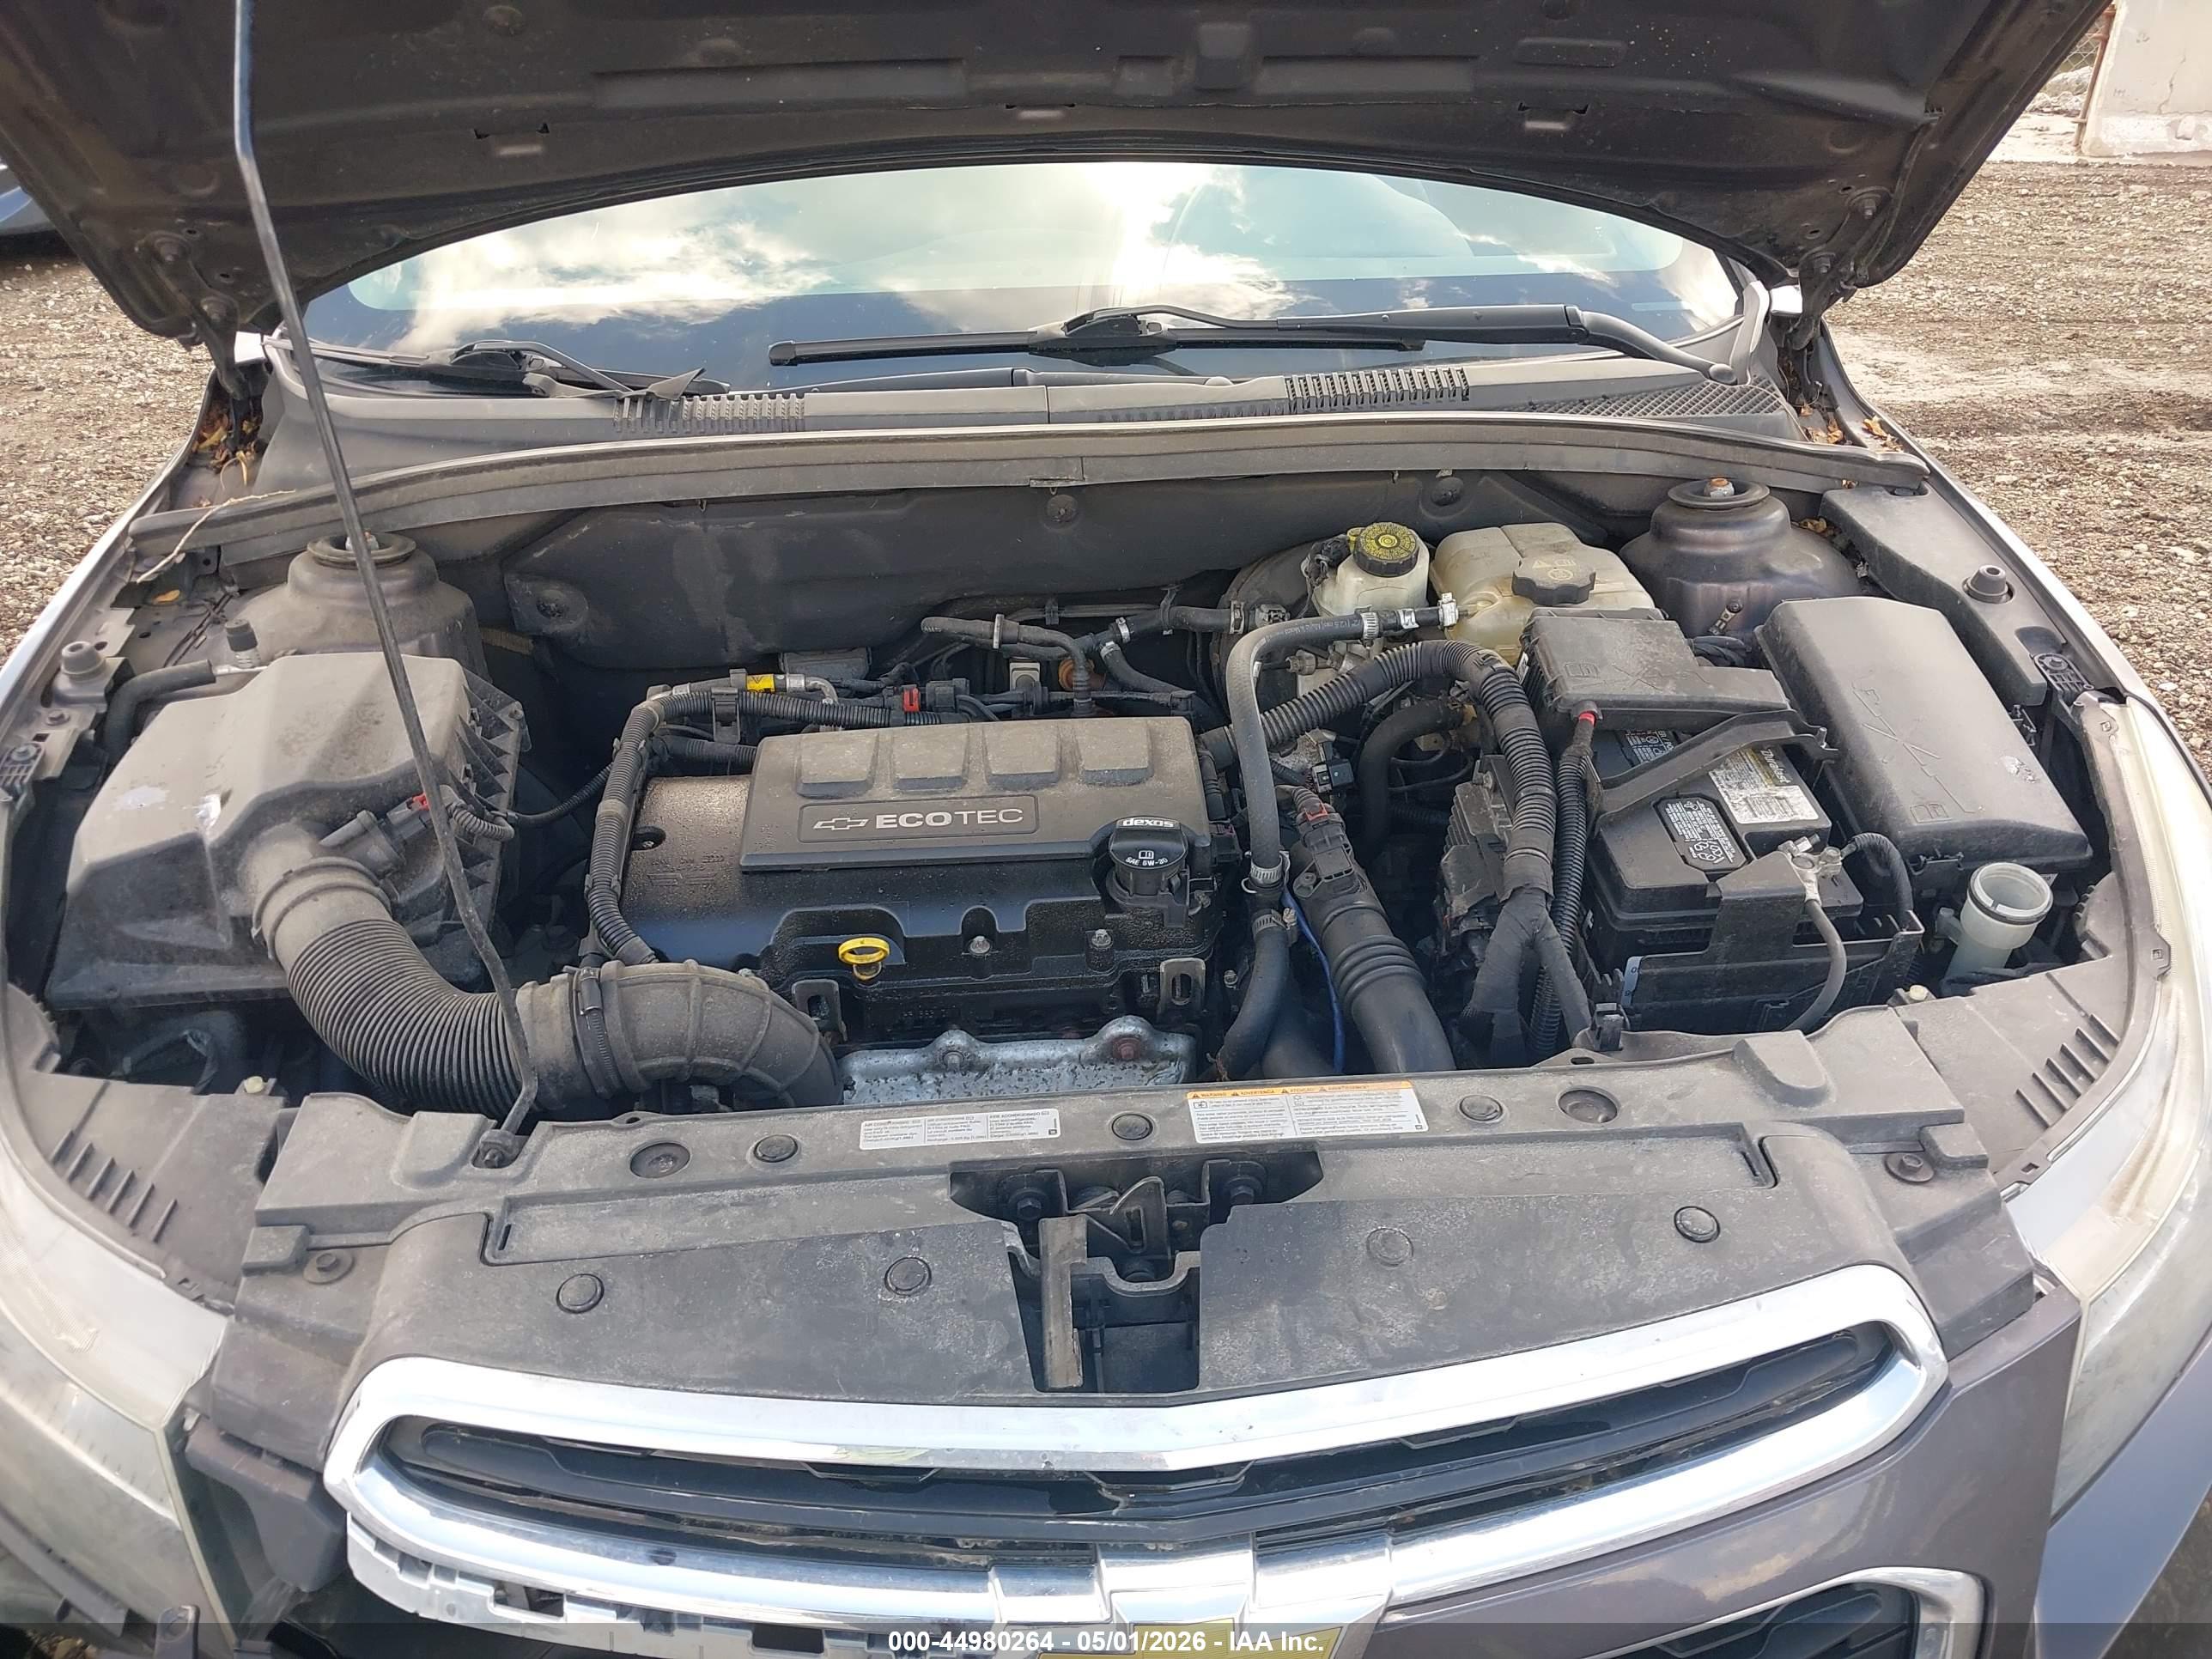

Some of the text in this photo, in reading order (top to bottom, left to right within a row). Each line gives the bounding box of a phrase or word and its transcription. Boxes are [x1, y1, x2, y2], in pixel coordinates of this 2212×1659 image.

[1760, 748, 1792, 783] Duralast
[876, 808, 1024, 829] ECOTEC
[1122, 817, 1175, 828] dexos
[1125, 856, 1140, 866] SAE
